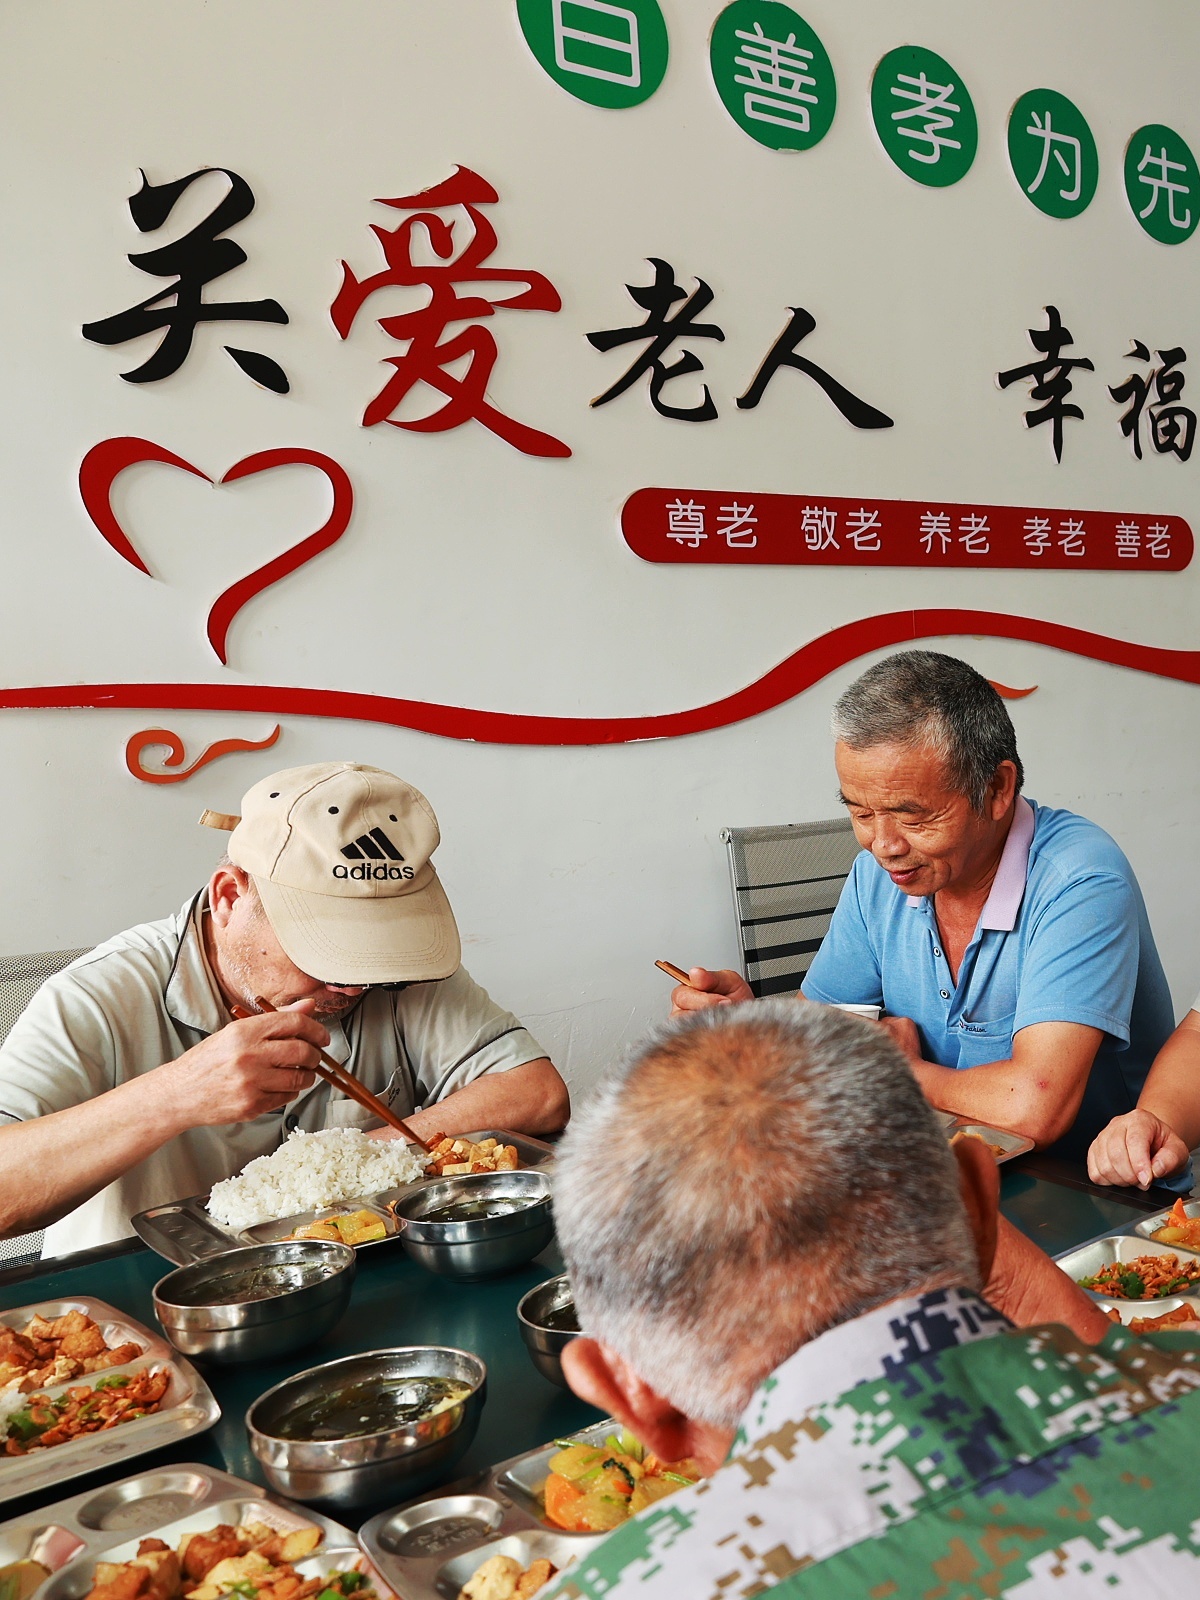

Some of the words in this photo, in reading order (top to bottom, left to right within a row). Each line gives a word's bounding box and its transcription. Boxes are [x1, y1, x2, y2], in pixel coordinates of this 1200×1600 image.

[81, 163, 894, 458] 关爱老人
[665, 498, 758, 548] 尊老
[800, 506, 882, 551] 敬老
[919, 510, 991, 555] 养老
[1022, 515, 1087, 556] 孝老
[1114, 520, 1171, 559] 善老
[332, 862, 415, 880] adidas
